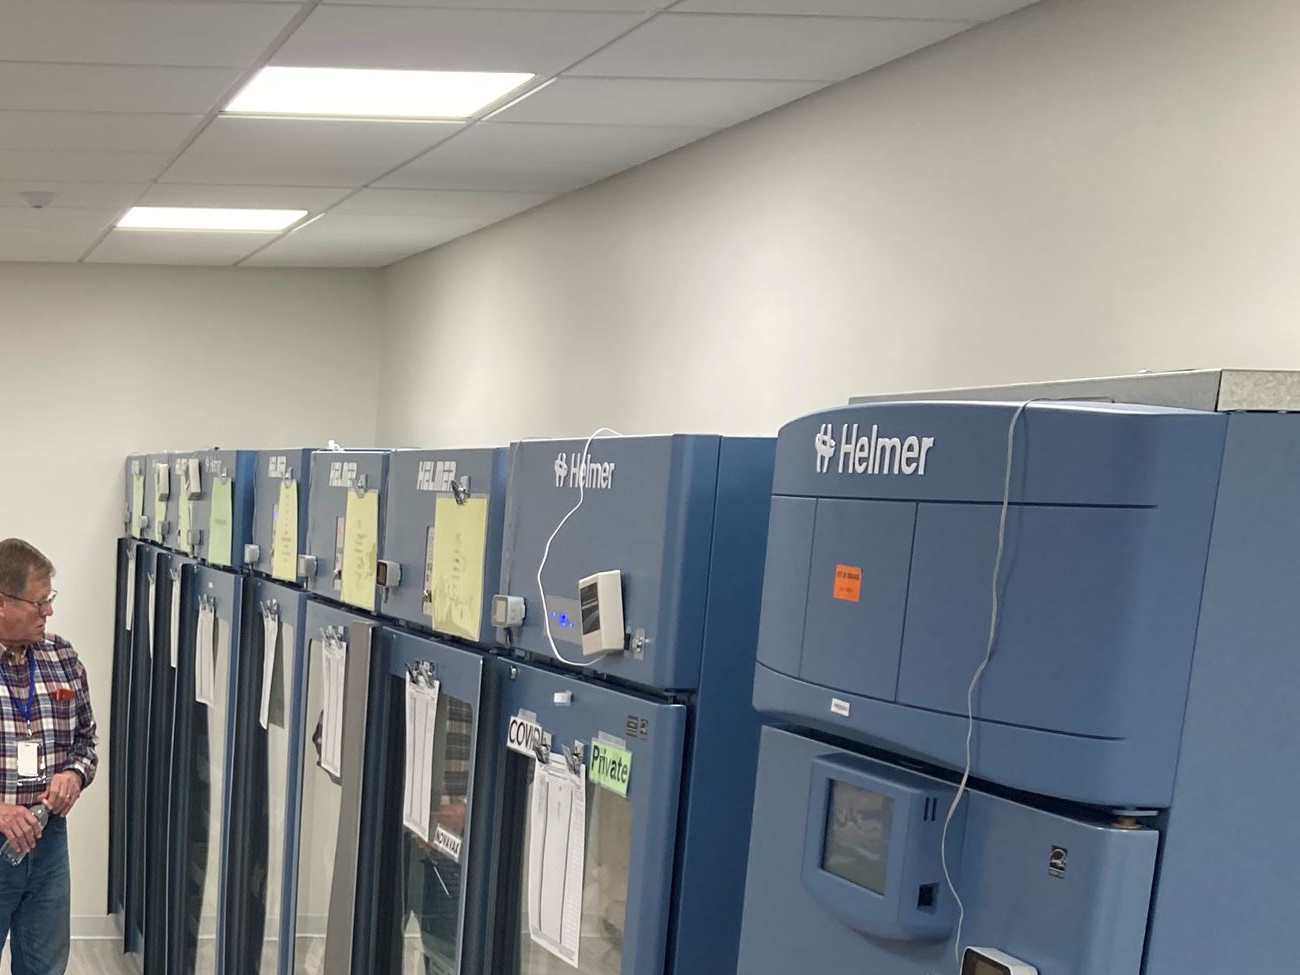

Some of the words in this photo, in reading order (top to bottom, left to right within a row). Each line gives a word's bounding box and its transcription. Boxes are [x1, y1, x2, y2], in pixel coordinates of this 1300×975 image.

[838, 423, 935, 475] Helmer
[569, 453, 615, 489] Helmer
[591, 744, 628, 784] Private
